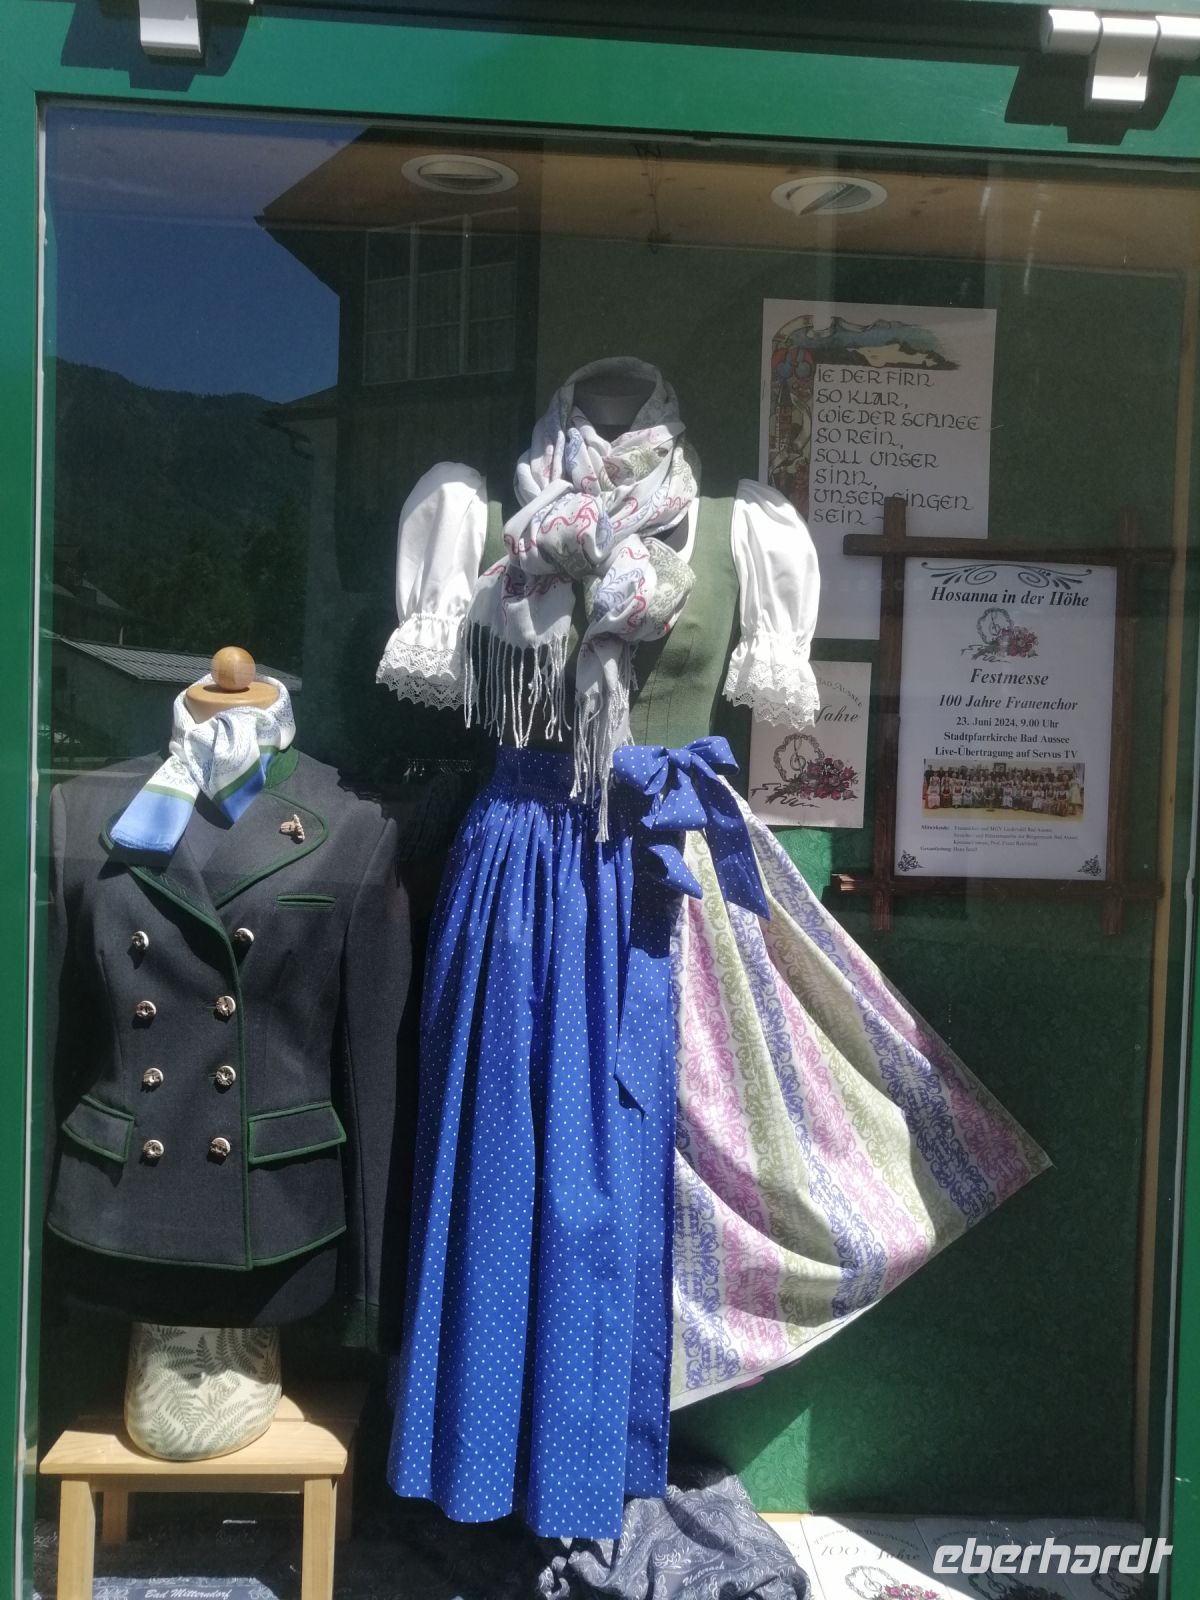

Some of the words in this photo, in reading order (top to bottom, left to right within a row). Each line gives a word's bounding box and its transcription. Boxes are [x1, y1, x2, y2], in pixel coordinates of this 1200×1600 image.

[840, 368, 881, 384] DER
[816, 389, 842, 403] SO
[859, 409, 897, 426] DER
[815, 428, 842, 444] SO
[815, 448, 862, 465] SOLL
[870, 451, 939, 468] UNSER
[814, 488, 885, 506] UNSER
[931, 586, 998, 604] Hosanna
[1002, 589, 1016, 604] in
[1020, 590, 1045, 605] der
[1049, 591, 1089, 607] Höhe
[970, 668, 1049, 686] Festmesse
[939, 694, 962, 707] 100
[966, 695, 1001, 708] Jahre
[1005, 696, 1078, 710] Frauenchor
[956, 716, 970, 726] 23.
[972, 717, 992, 726] Juni
[1020, 718, 1040, 728] 9.00
[1042, 719, 1059, 729] Uhr
[943, 731, 1018, 743] Stadtpfarrkirche
[1020, 733, 1038, 743] Bad
[1040, 735, 1070, 744] Aussee
[935, 745, 1014, 759] Live-Übertragung
[1016, 748, 1030, 758] auf
[1032, 749, 1061, 759] Servus
[1063, 750, 1078, 759] TV
